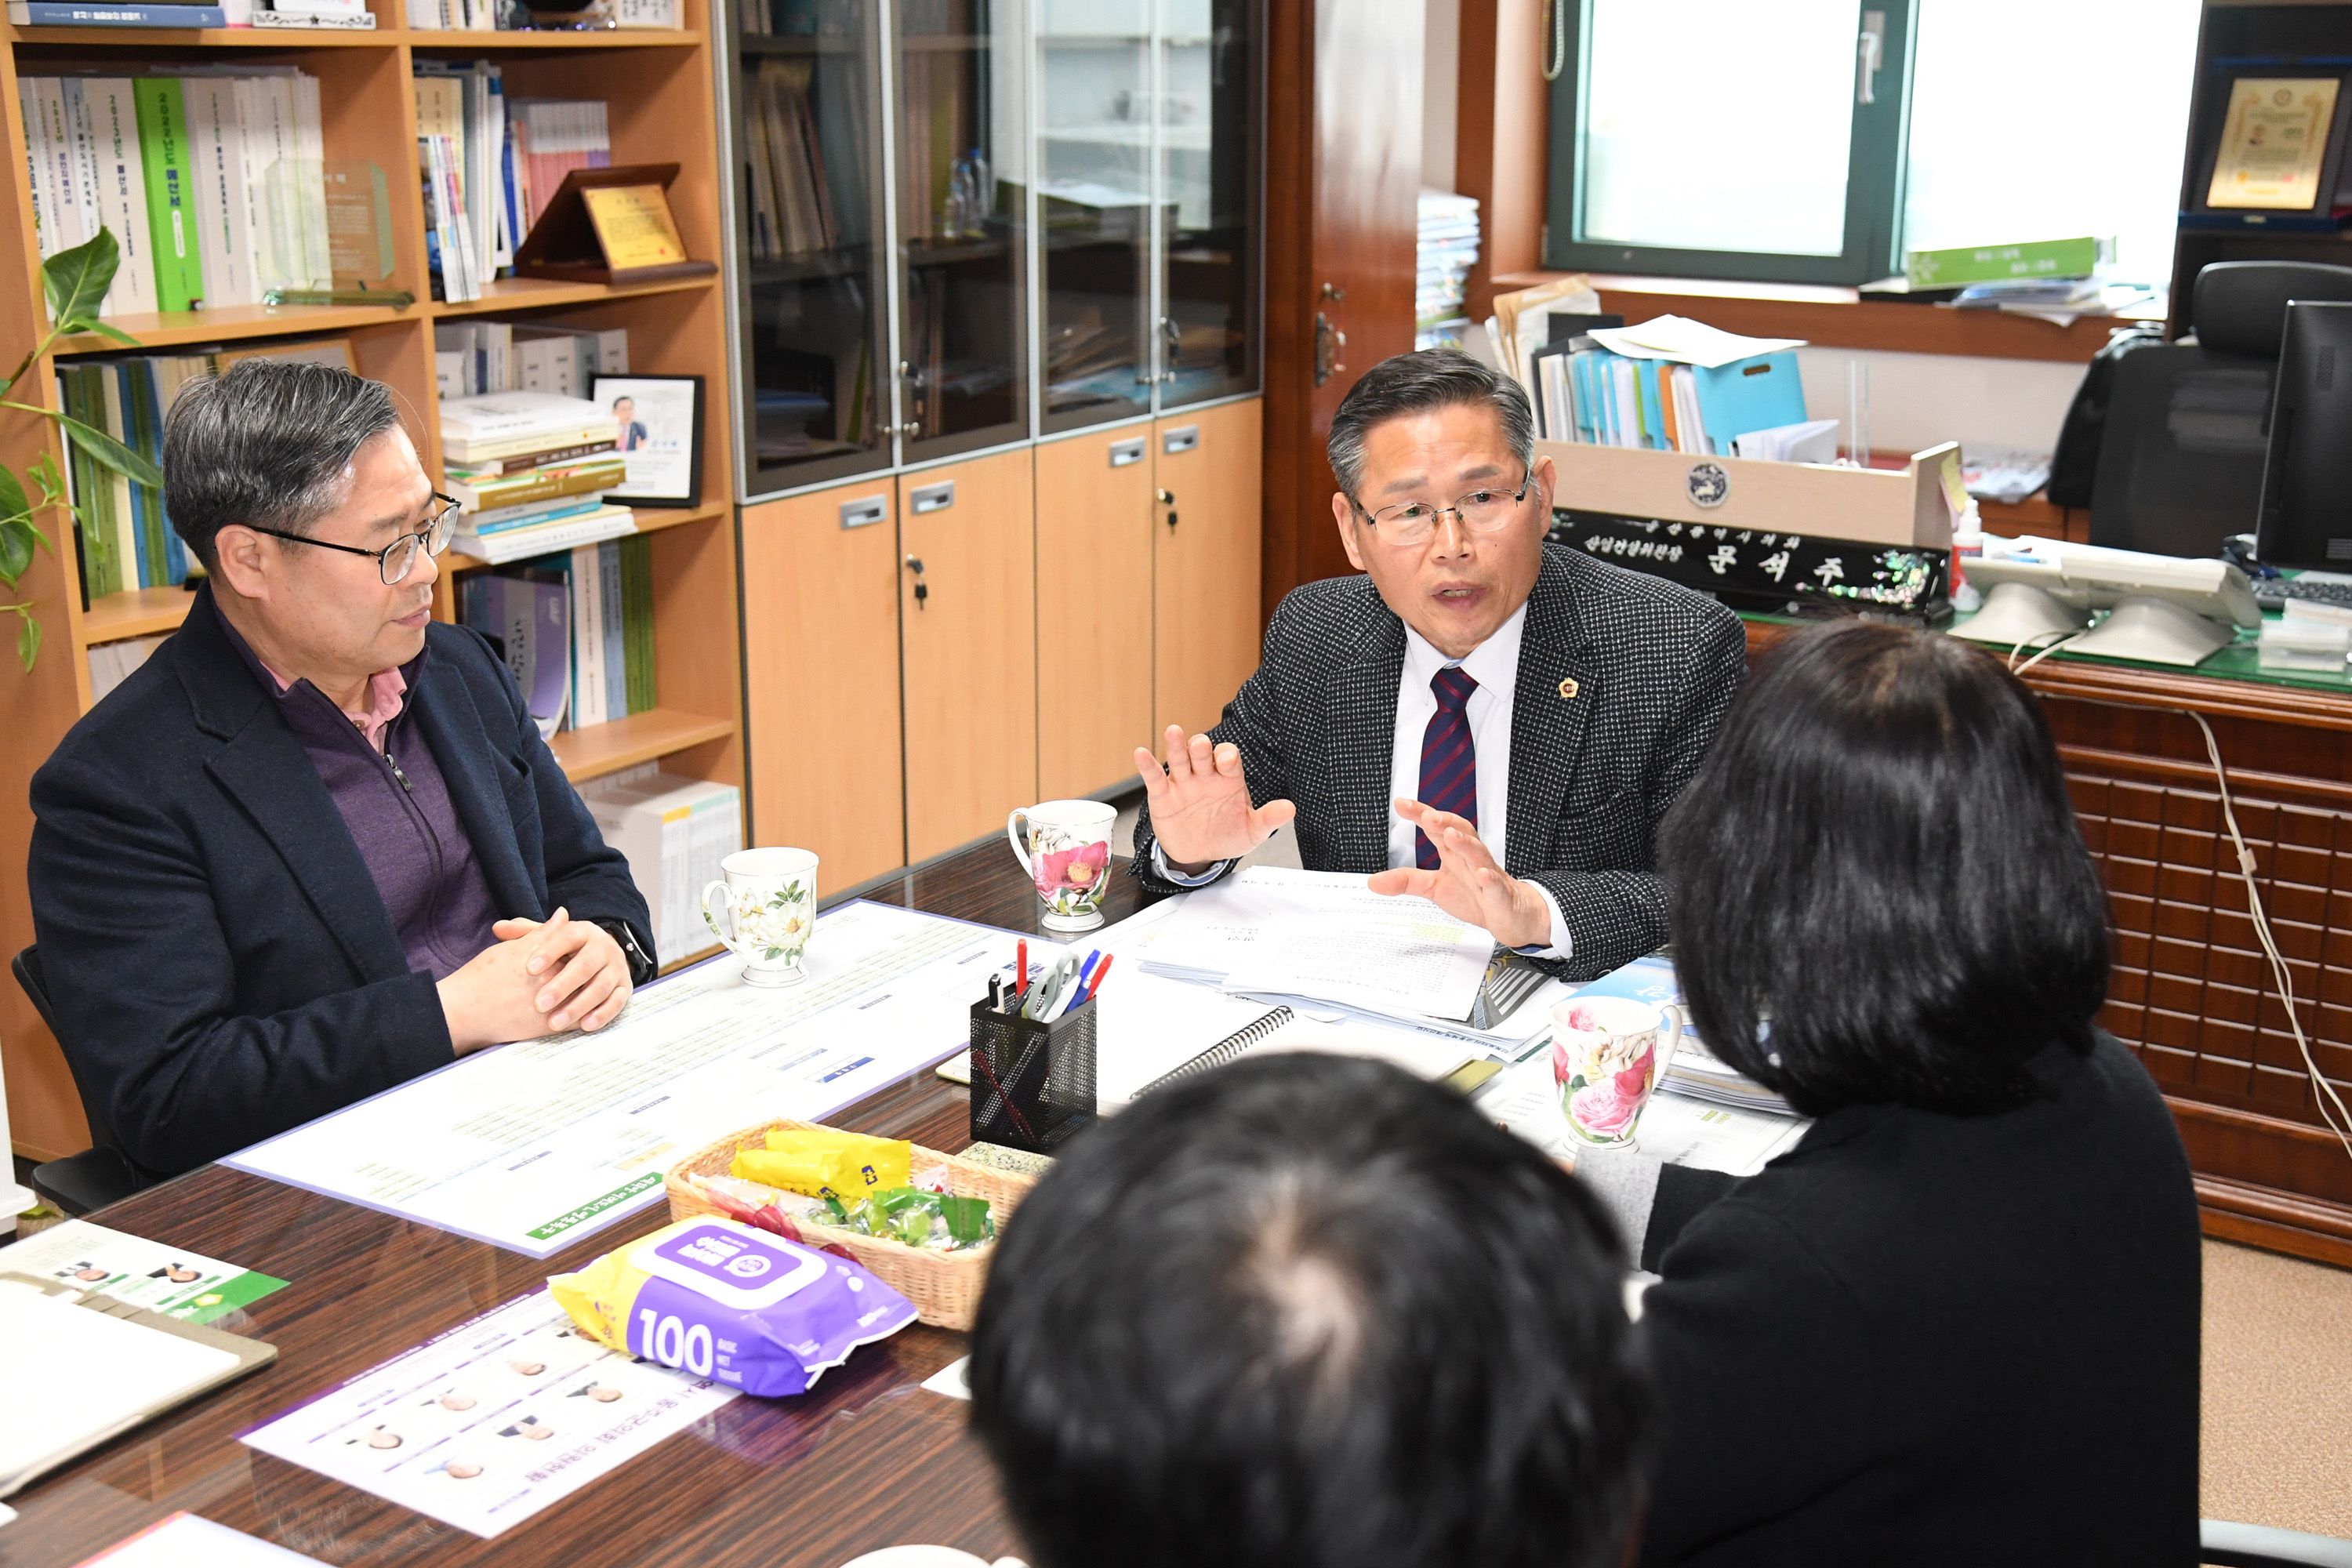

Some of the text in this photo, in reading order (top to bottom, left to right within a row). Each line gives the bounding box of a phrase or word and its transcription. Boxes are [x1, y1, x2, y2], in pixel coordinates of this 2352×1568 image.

[1646, 520, 1800, 550] 울산광역시의회
[1584, 535, 1845, 586] 산업건설위원장 문석주
[639, 1308, 713, 1377] 100
[717, 1354, 731, 1367] WET
[597, 1399, 678, 1442] 울주군의회
[524, 1446, 597, 1483] 의원현황
